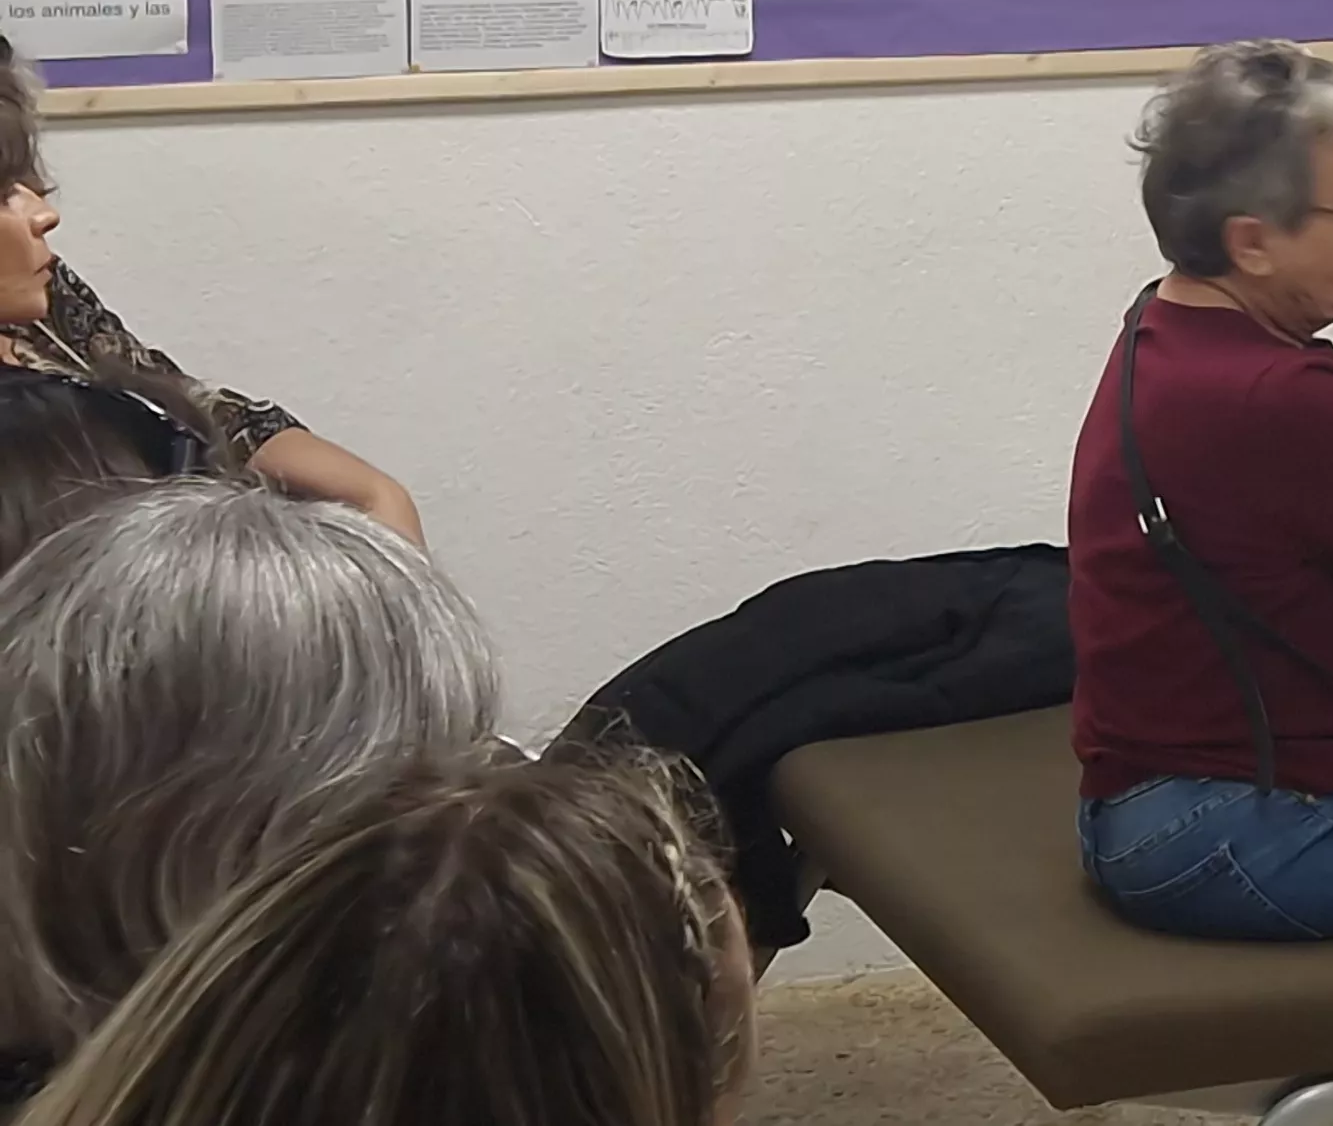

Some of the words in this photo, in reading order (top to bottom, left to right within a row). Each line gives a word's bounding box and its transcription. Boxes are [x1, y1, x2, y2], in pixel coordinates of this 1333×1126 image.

[9, 4, 35, 18] los
[41, 2, 123, 17] animales
[129, 4, 140, 19] y
[146, 1, 171, 16] las
